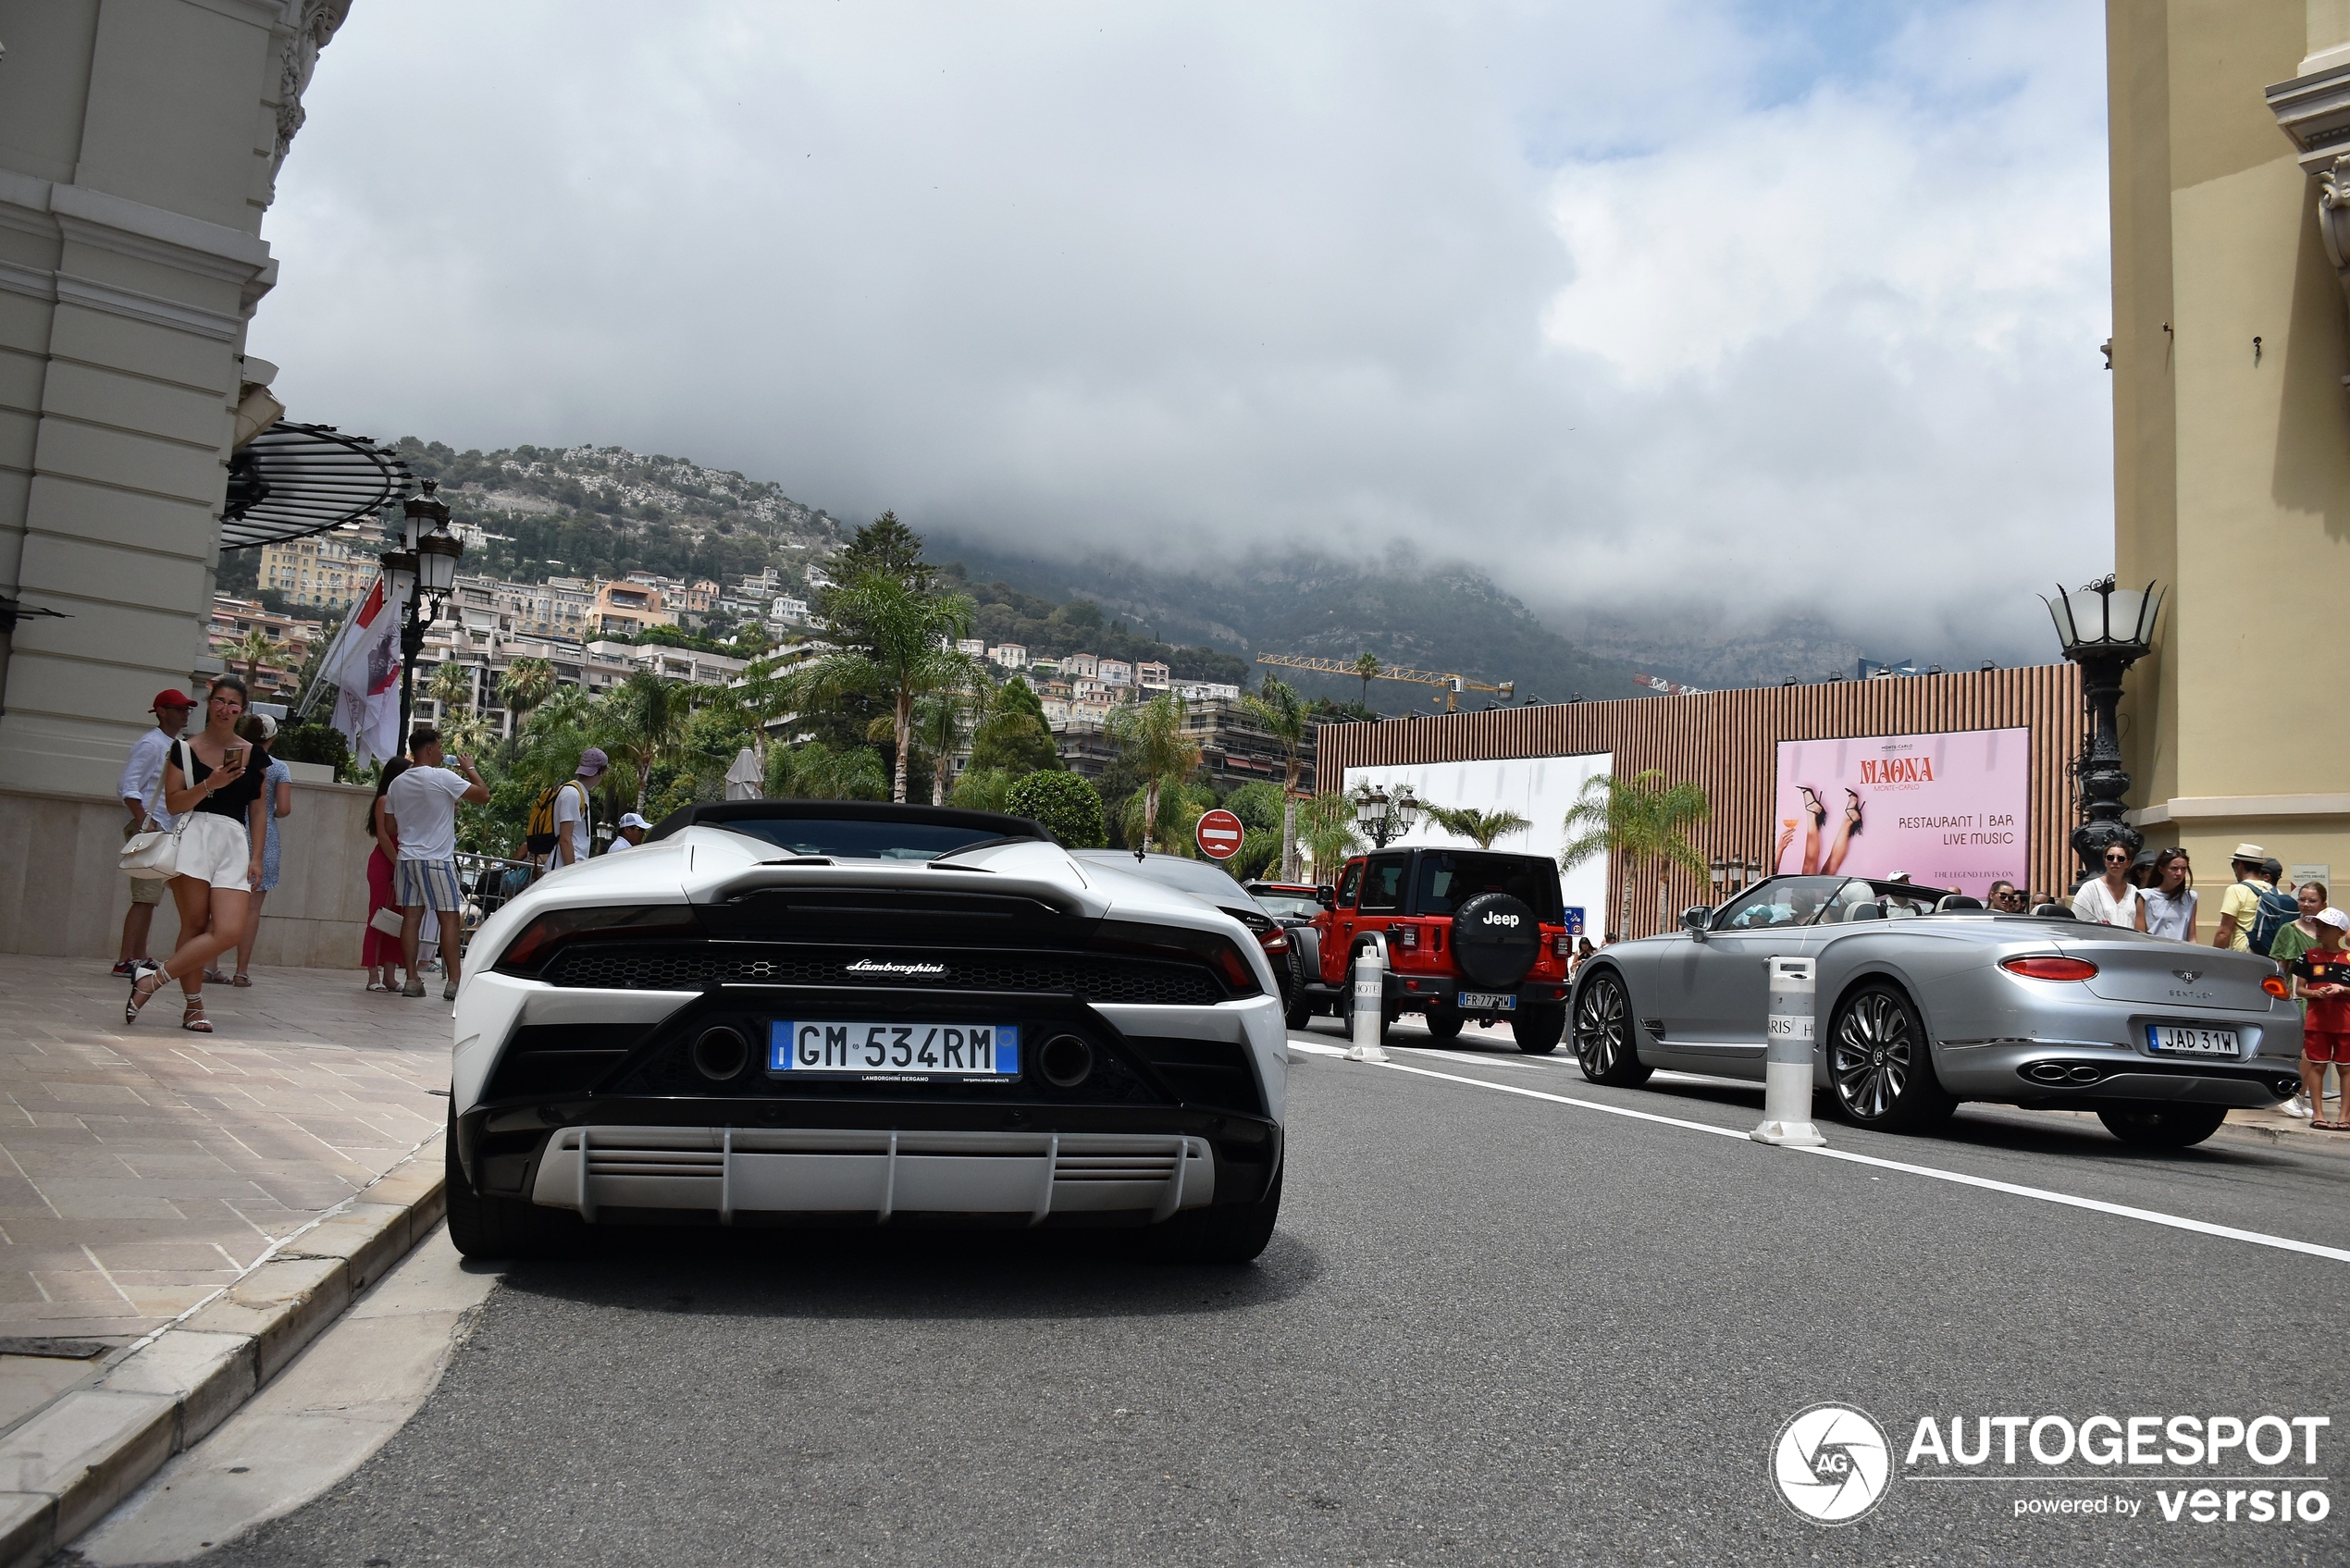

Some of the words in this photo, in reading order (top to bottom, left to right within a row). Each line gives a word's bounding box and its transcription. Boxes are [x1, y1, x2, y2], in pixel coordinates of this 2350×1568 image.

[1860, 757, 1935, 784] MAONA
[1874, 784, 1920, 792] MONTE-CARLO
[1899, 816, 1973, 829] RESTAURANT
[1989, 815, 2014, 826] BAR
[1943, 833, 1967, 846] LIVE
[1970, 833, 2014, 845] MUSIC
[1482, 910, 1519, 928] Jeep
[846, 958, 945, 975] Lamborghini
[1466, 994, 1478, 1005] FR
[2169, 989, 2213, 999] BENTLEY
[1804, 1024, 1814, 1037] H
[798, 1026, 847, 1067] GM
[865, 1027, 991, 1068] 534RM
[2165, 1029, 2196, 1049] JAD
[2201, 1031, 2232, 1052] 31W
